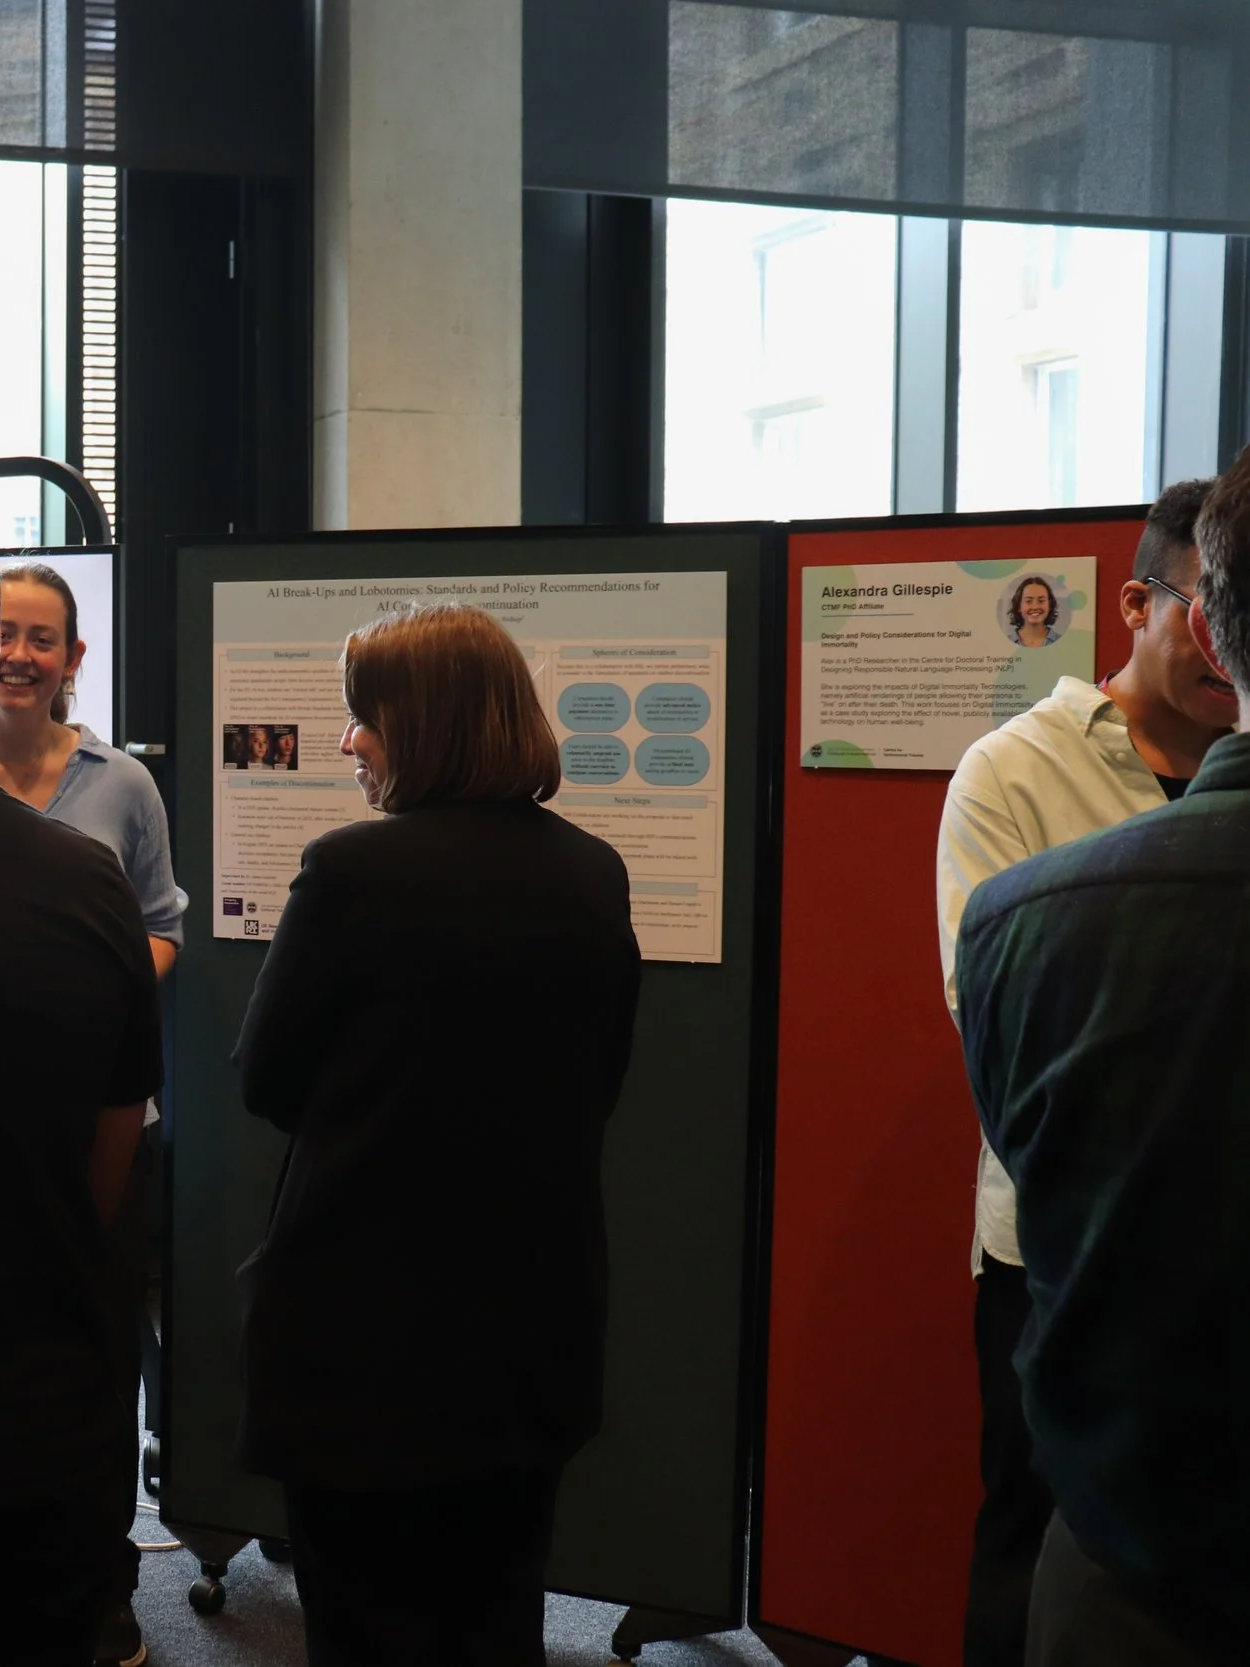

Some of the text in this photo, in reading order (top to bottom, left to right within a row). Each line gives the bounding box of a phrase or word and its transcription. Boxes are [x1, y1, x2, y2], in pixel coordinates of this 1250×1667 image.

[267, 580, 661, 599] AI Break-Ups and Lobotomies: Standards and Policy Recommendations for
[821, 583, 954, 598] Alexandra Gillespie
[376, 602, 390, 612] AI
[821, 632, 845, 640] Design
[860, 632, 881, 640] Policy
[883, 631, 935, 639] Considerations
[949, 630, 972, 639] Digital
[821, 641, 858, 649] Immortality
[592, 649, 619, 657] Spheres
[629, 648, 677, 656] Consideration
[986, 656, 1014, 664] Training
[820, 666, 852, 674] Designing
[920, 666, 953, 674] Language
[954, 665, 993, 674] Processing
[919, 683, 940, 691] Digital
[941, 683, 979, 691] Immortality
[972, 701, 994, 709] Digital
[632, 797, 651, 806] Steps
